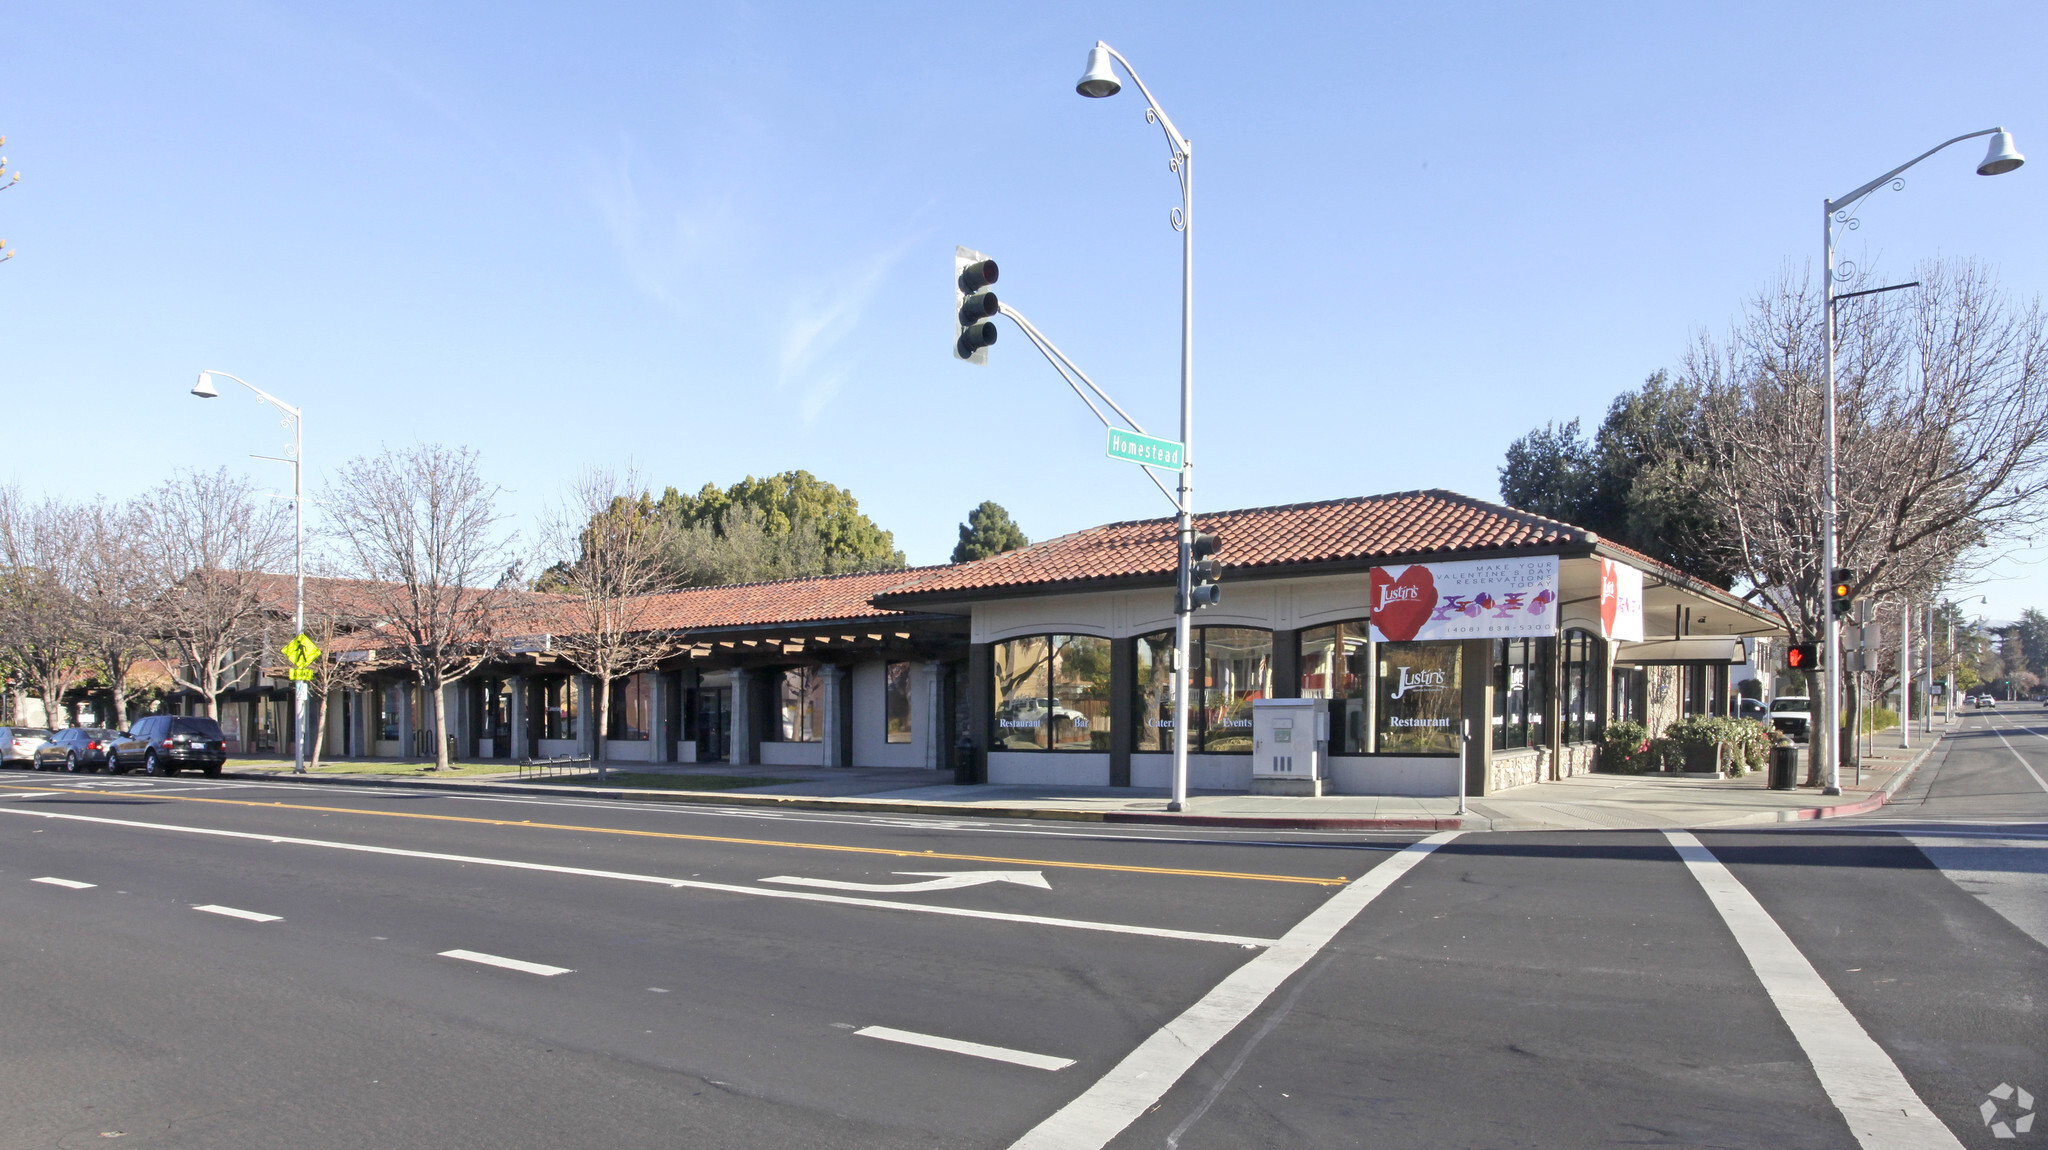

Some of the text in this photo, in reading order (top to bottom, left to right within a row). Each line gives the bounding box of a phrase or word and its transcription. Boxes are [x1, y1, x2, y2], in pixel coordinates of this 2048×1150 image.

[1112, 434, 1178, 465] Homestead
[1476, 561, 1552, 571] MAKE YOUR
[1528, 568, 1552, 576] DAY
[1456, 575, 1552, 585] RESERVATIONS
[1373, 584, 1420, 613] Justin's
[1391, 666, 1446, 700] Justin's
[1000, 718, 1090, 728] Restaurant Bar
[1148, 717, 1253, 728] Cateri Events
[1390, 716, 1450, 727] Restaurant
